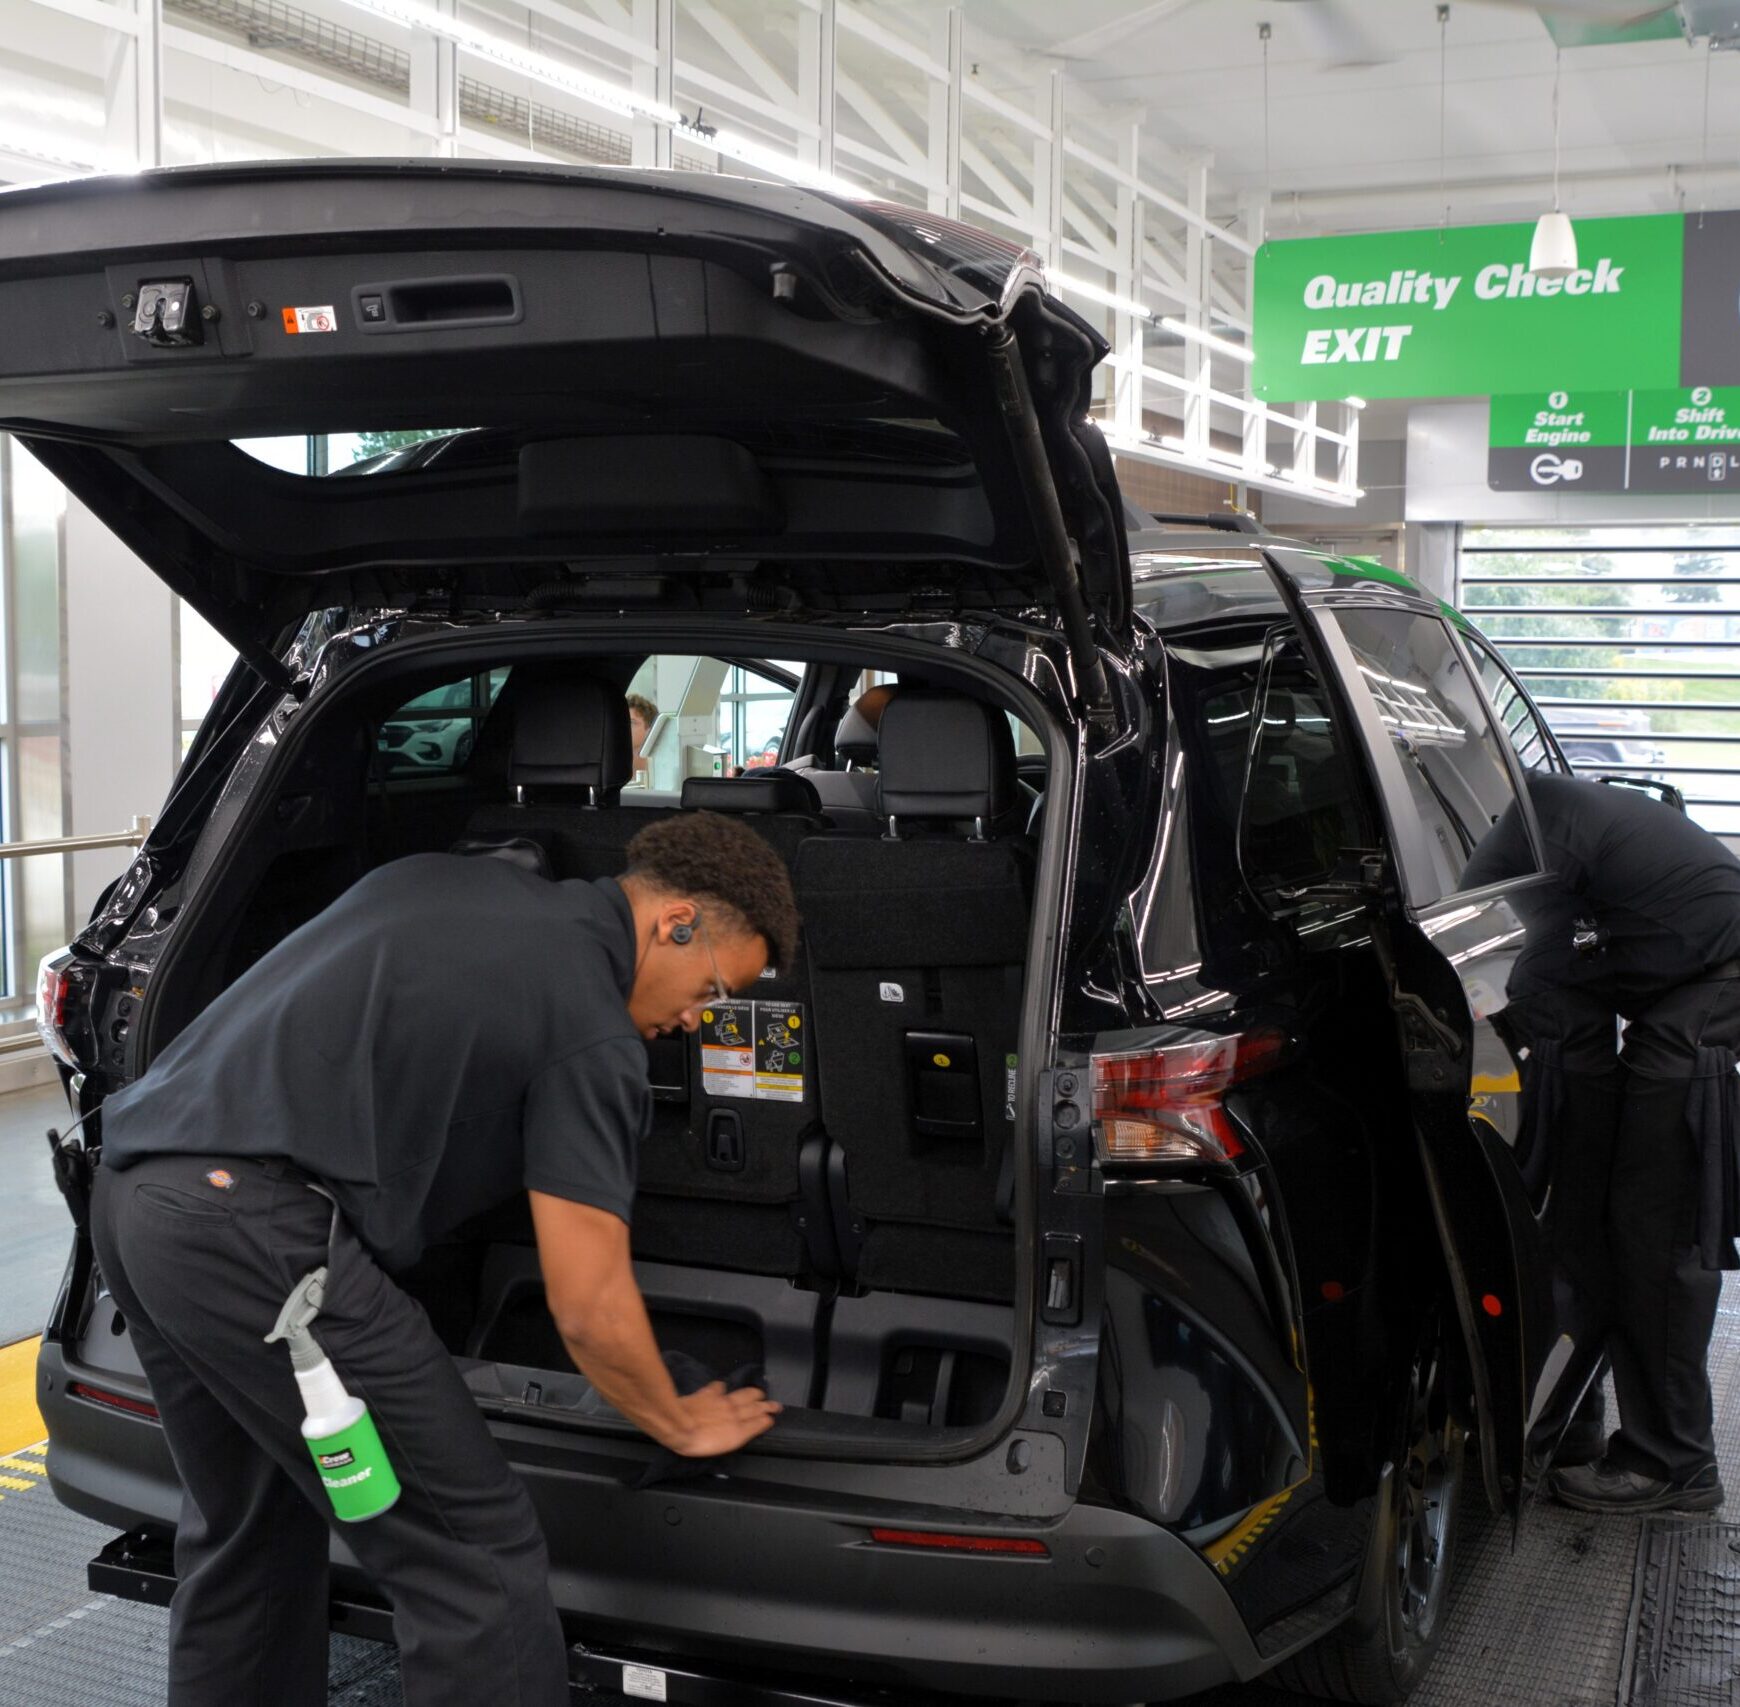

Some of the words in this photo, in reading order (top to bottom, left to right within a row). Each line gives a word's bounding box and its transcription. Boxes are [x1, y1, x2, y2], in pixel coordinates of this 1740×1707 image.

[1303, 269, 1462, 310] Quality
[1474, 257, 1625, 300] Check
[1300, 325, 1413, 365] EXIT
[1534, 411, 1585, 426] Start
[1675, 407, 1725, 424] Shift
[1524, 428, 1591, 447] Engine
[1648, 426, 1690, 441] Into
[1695, 424, 1740, 440] Driv
[1659, 456, 1670, 468] P
[1676, 456, 1687, 468] R
[1693, 456, 1705, 468] N
[1712, 456, 1723, 468] D
[1730, 455, 1740, 468] L
[1008, 1069, 1016, 1093] RECLINE
[1008, 1094, 1016, 1102] TO
